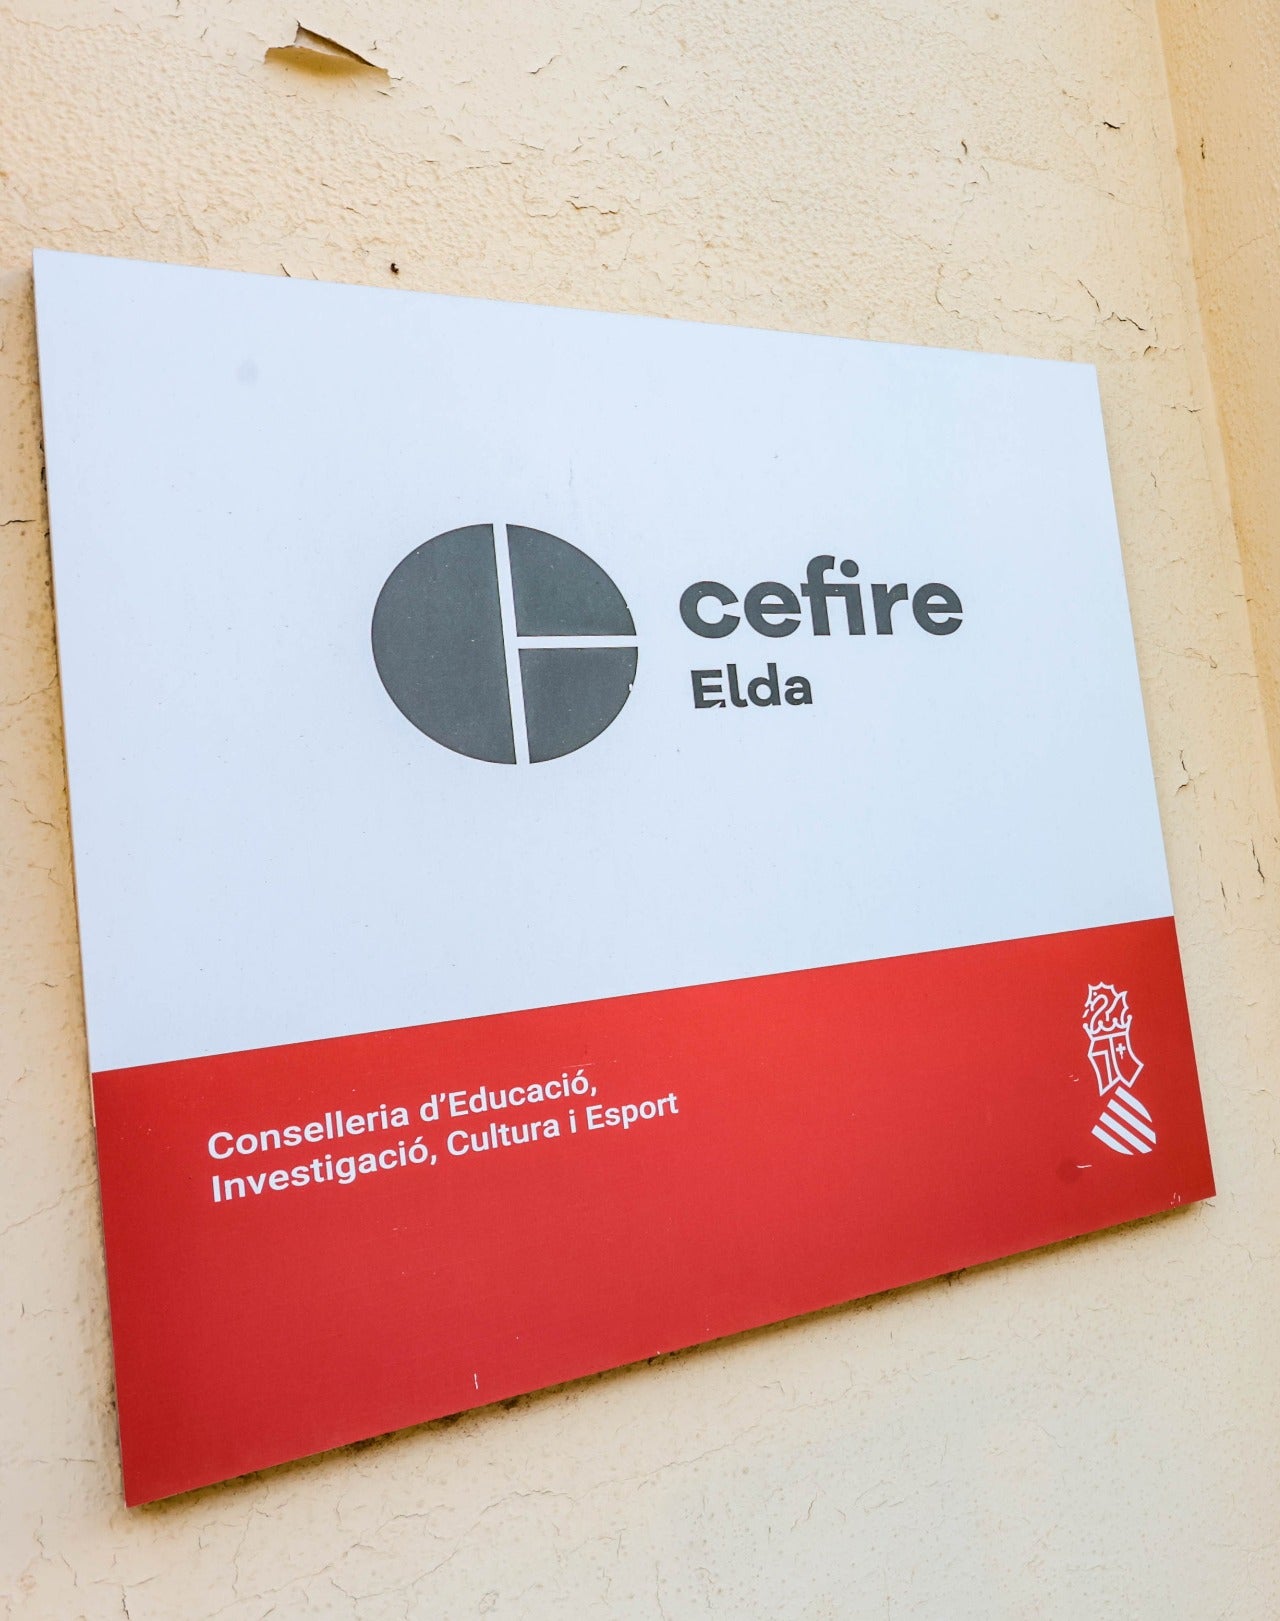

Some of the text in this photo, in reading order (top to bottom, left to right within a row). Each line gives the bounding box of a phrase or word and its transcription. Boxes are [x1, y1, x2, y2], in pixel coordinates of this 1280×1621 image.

[679, 554, 963, 639] cefire
[690, 662, 813, 709] Elda
[207, 1103, 409, 1160] Conselleria
[212, 1093, 679, 1203] Investigació, Cultura i Esport
